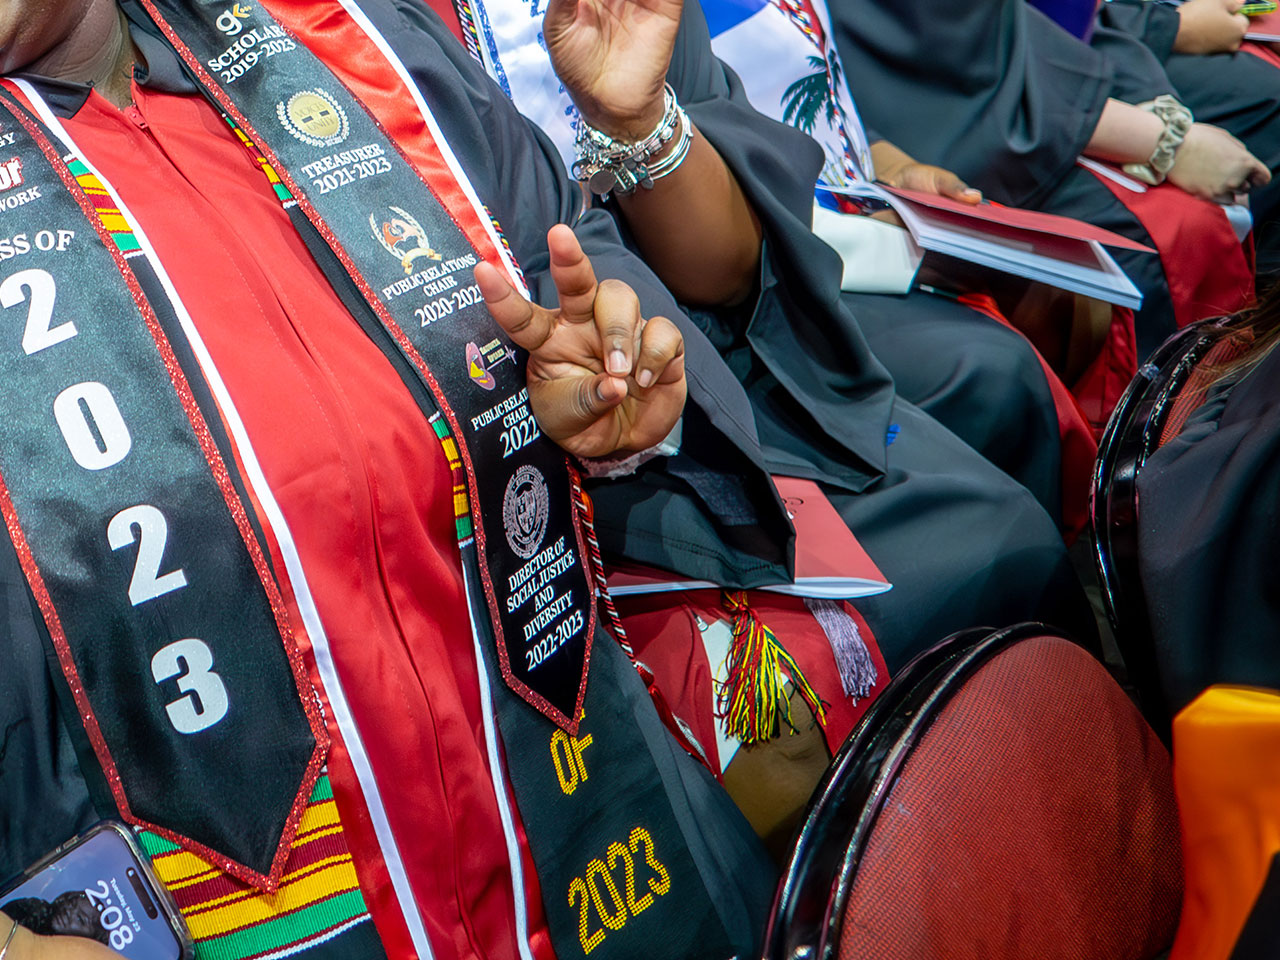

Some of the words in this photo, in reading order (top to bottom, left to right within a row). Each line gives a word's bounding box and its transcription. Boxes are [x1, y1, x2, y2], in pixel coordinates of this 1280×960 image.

[220, 38, 297, 85] 2019-2023
[301, 143, 385, 180] TREASURER
[312, 156, 393, 195] 2021-2023
[34, 229, 76, 252] OF
[423, 275, 458, 298] CHAIR
[503, 404, 530, 429] CHAIR
[506, 575, 541, 614] SOCIAL
[539, 549, 576, 588] JUSTICE
[508, 544, 556, 592] DIRECTOR
[554, 535, 566, 558] OF
[523, 590, 574, 642] DIVERSITY
[534, 585, 555, 613] AND
[525, 609, 585, 672] 2022-2023
[567, 826, 671, 956] 2023
[84, 879, 134, 951] 2:08
